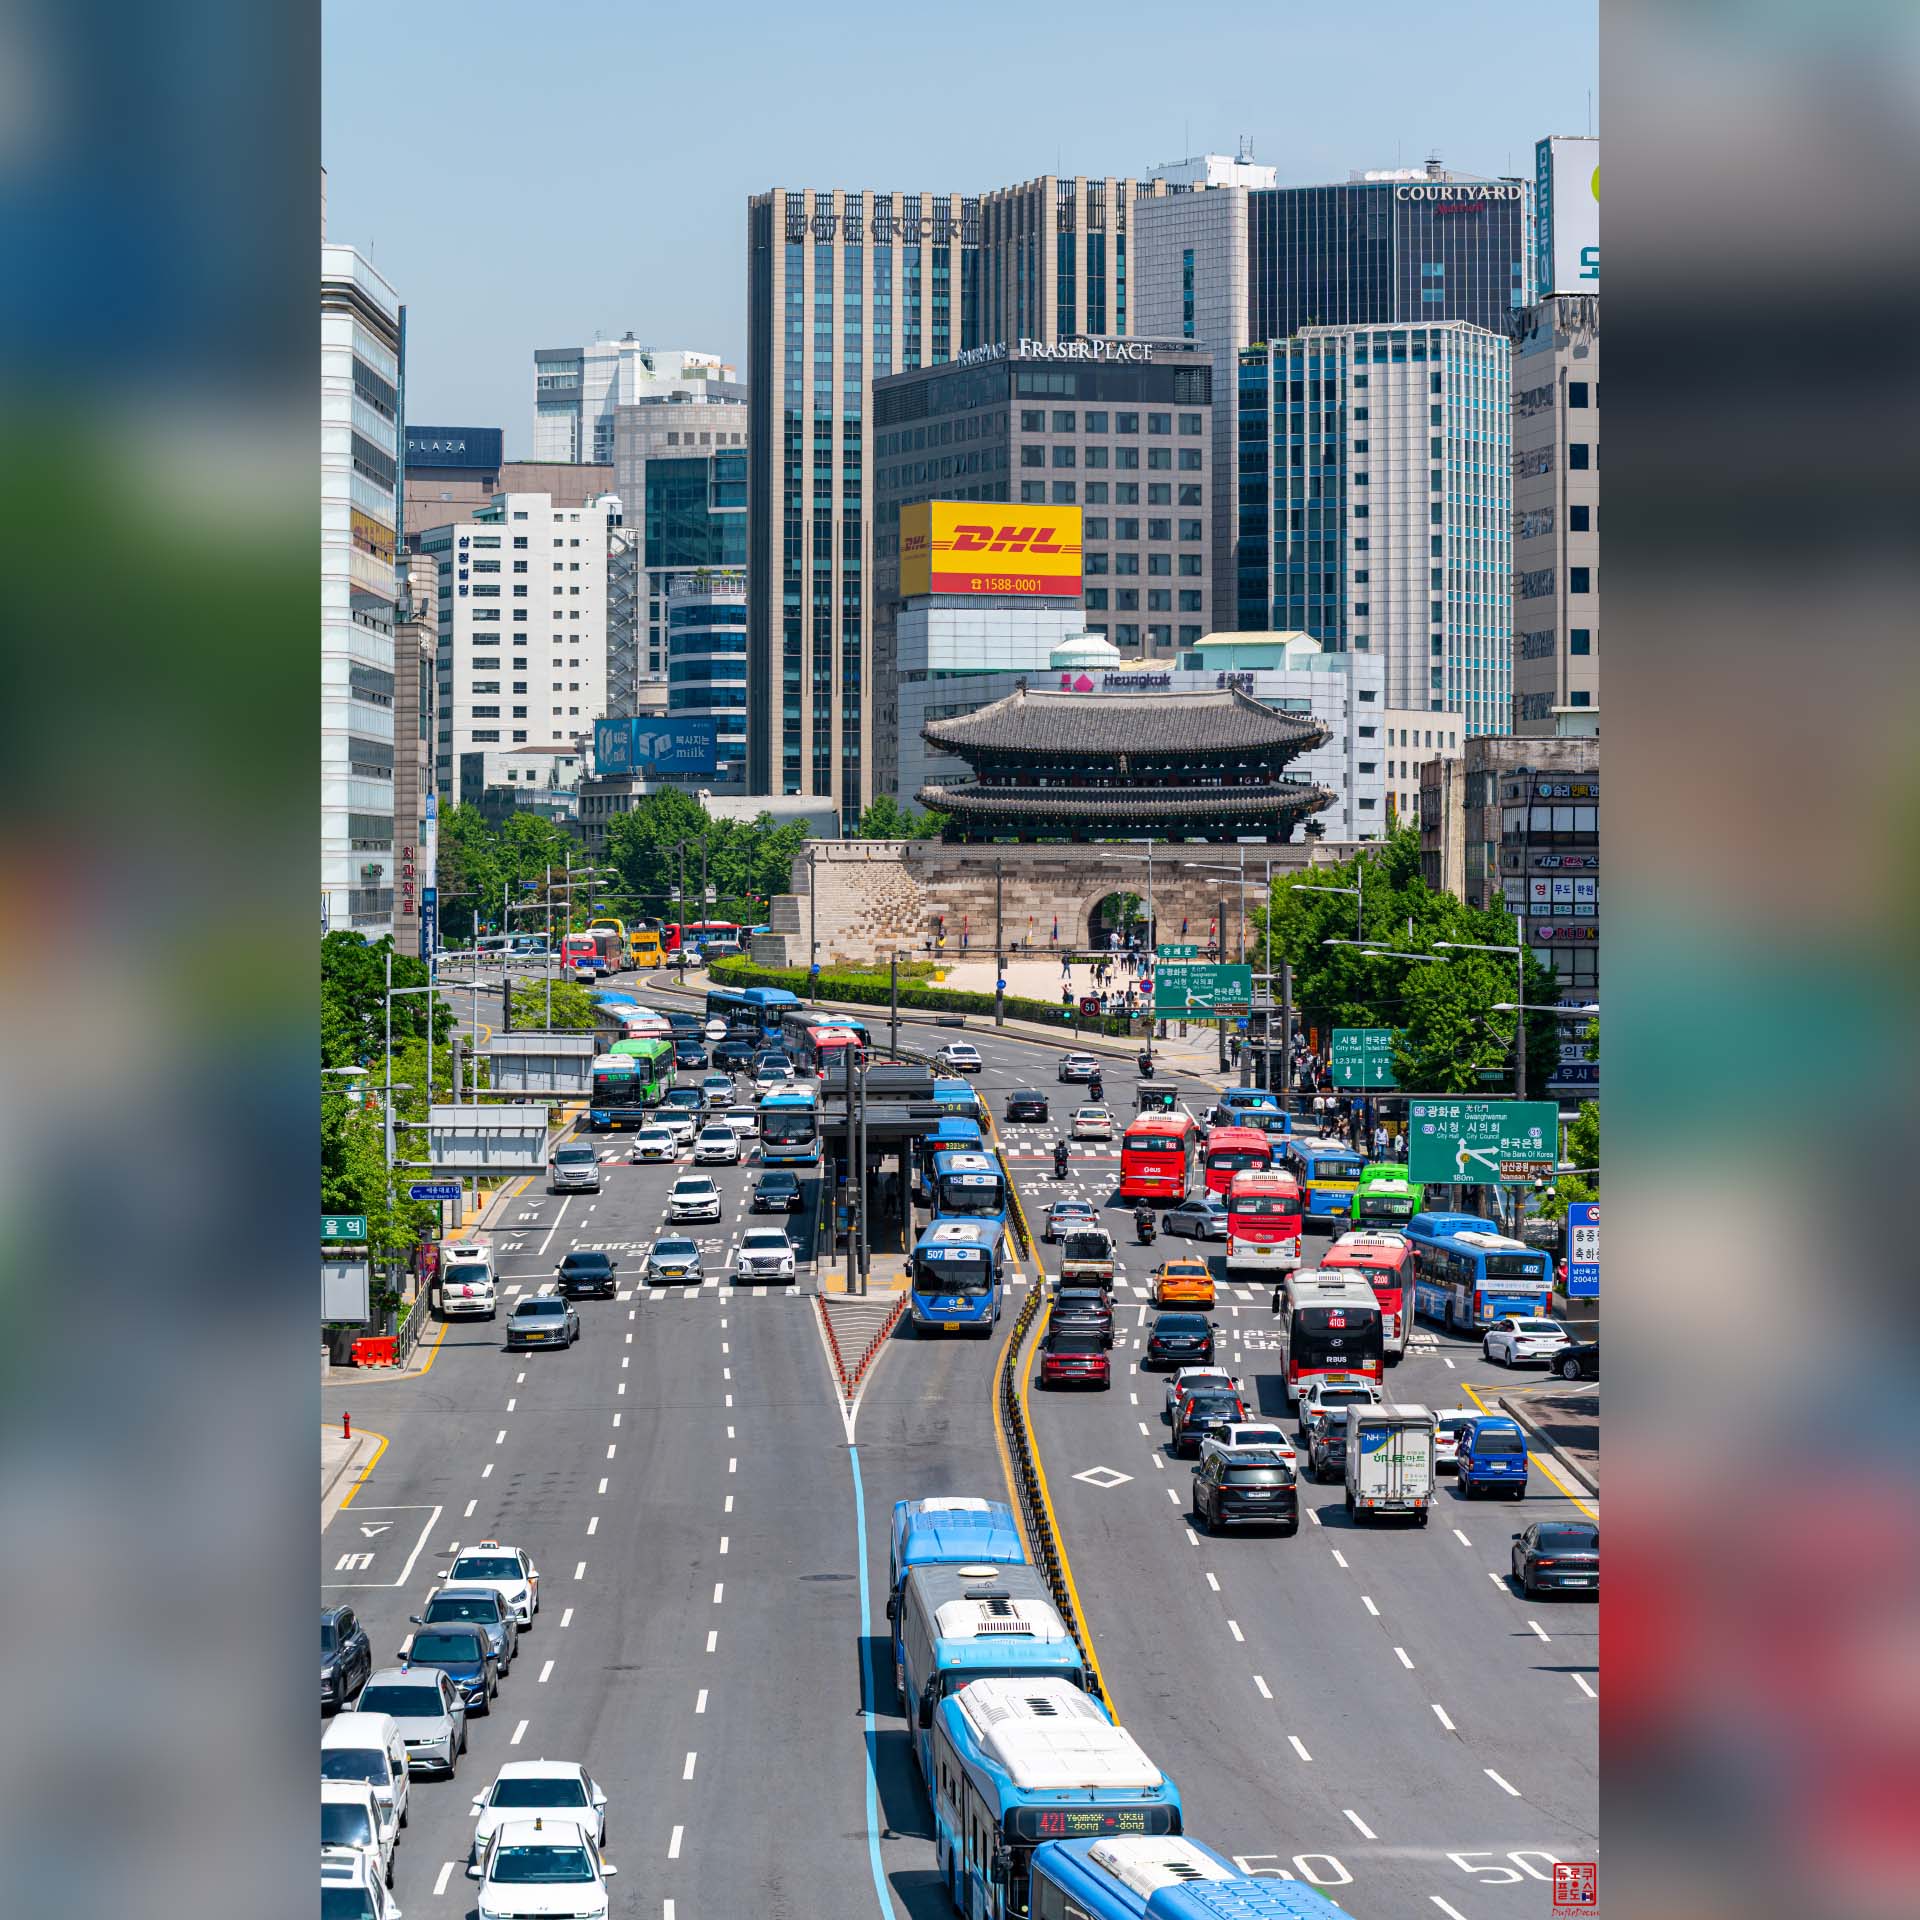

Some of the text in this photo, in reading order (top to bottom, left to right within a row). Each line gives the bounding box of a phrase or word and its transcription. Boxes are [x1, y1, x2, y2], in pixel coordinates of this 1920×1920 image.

[1396, 186, 1522, 201] COURTYARD
[408, 440, 466, 452] PLAZA
[904, 535, 928, 551] DHL
[951, 525, 1063, 553] DHL
[985, 578, 1041, 592] 1588-0001
[1104, 673, 1171, 689] Heungkuk
[1553, 784, 1570, 797] 승리
[1540, 856, 1560, 867] 사교
[402, 846, 415, 914] 치과재료
[1535, 883, 1594, 896] 영 무도 학원
[1085, 1002, 1096, 1012] 50
[1341, 1036, 1358, 1045] 시청
[1427, 1105, 1460, 1118] 광화문
[1437, 1121, 1500, 1133] 시청 시의회
[1500, 1138, 1543, 1149] 한국은행
[1349, 1168, 1360, 1176] 103
[1501, 1162, 1529, 1172] 남산공원
[950, 1176, 963, 1184] 152
[928, 1251, 943, 1259] 507
[1524, 1265, 1539, 1273] 402
[1374, 1275, 1388, 1284] 9200
[1329, 1317, 1345, 1328] 4103
[1366, 1433, 1379, 1441] NH
[1040, 1812, 1066, 1832] 421
[1232, 1854, 1354, 1885] 50
[1447, 1851, 1578, 1884] 50
